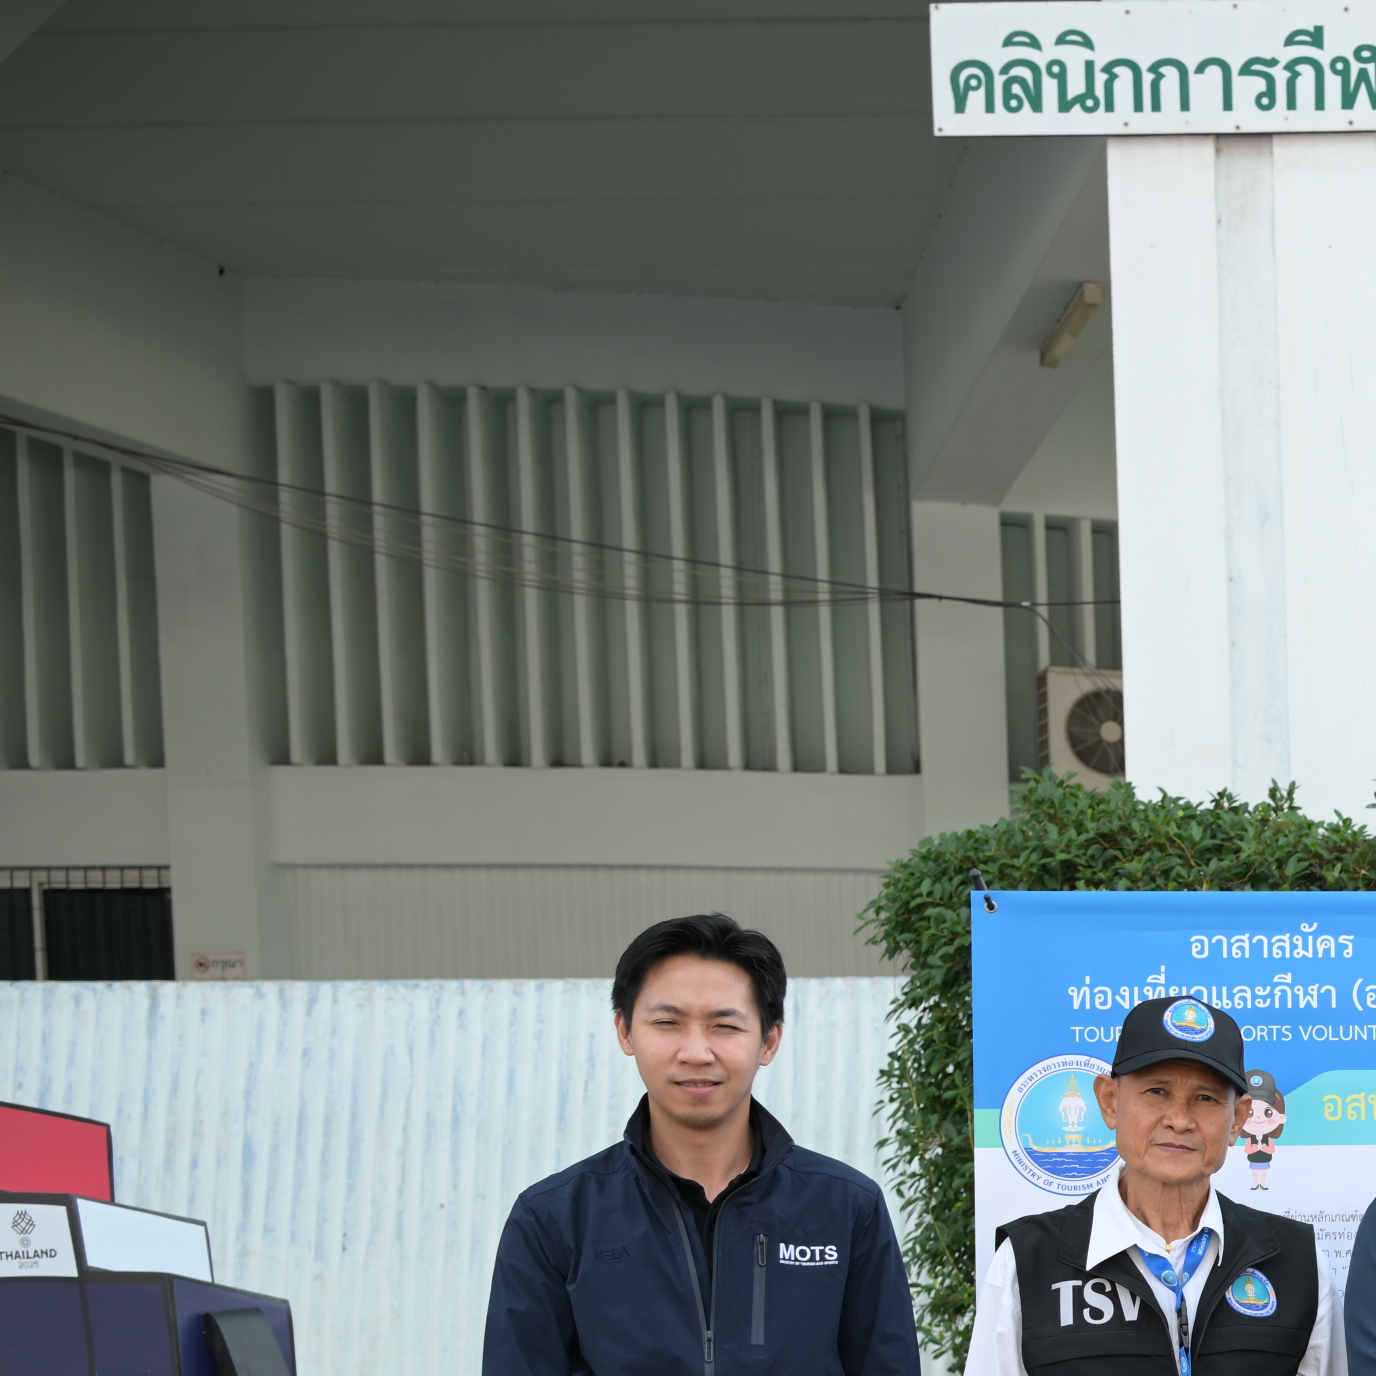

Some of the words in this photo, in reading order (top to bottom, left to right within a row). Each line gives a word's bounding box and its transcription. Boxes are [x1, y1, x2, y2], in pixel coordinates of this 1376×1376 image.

[1190, 922, 1355, 958] อาสาสมัคร
[1241, 1025, 1292, 1041] ORTS
[1011, 1149, 1043, 1182] MINISTRY
[1043, 1180, 1055, 1191] OF
[1056, 1182, 1094, 1192] TOURISM
[0, 1248, 57, 1261] THAILAND
[780, 1243, 838, 1261] MOTS
[18, 1260, 39, 1269] 2025
[1051, 1277, 1141, 1327] TSV
